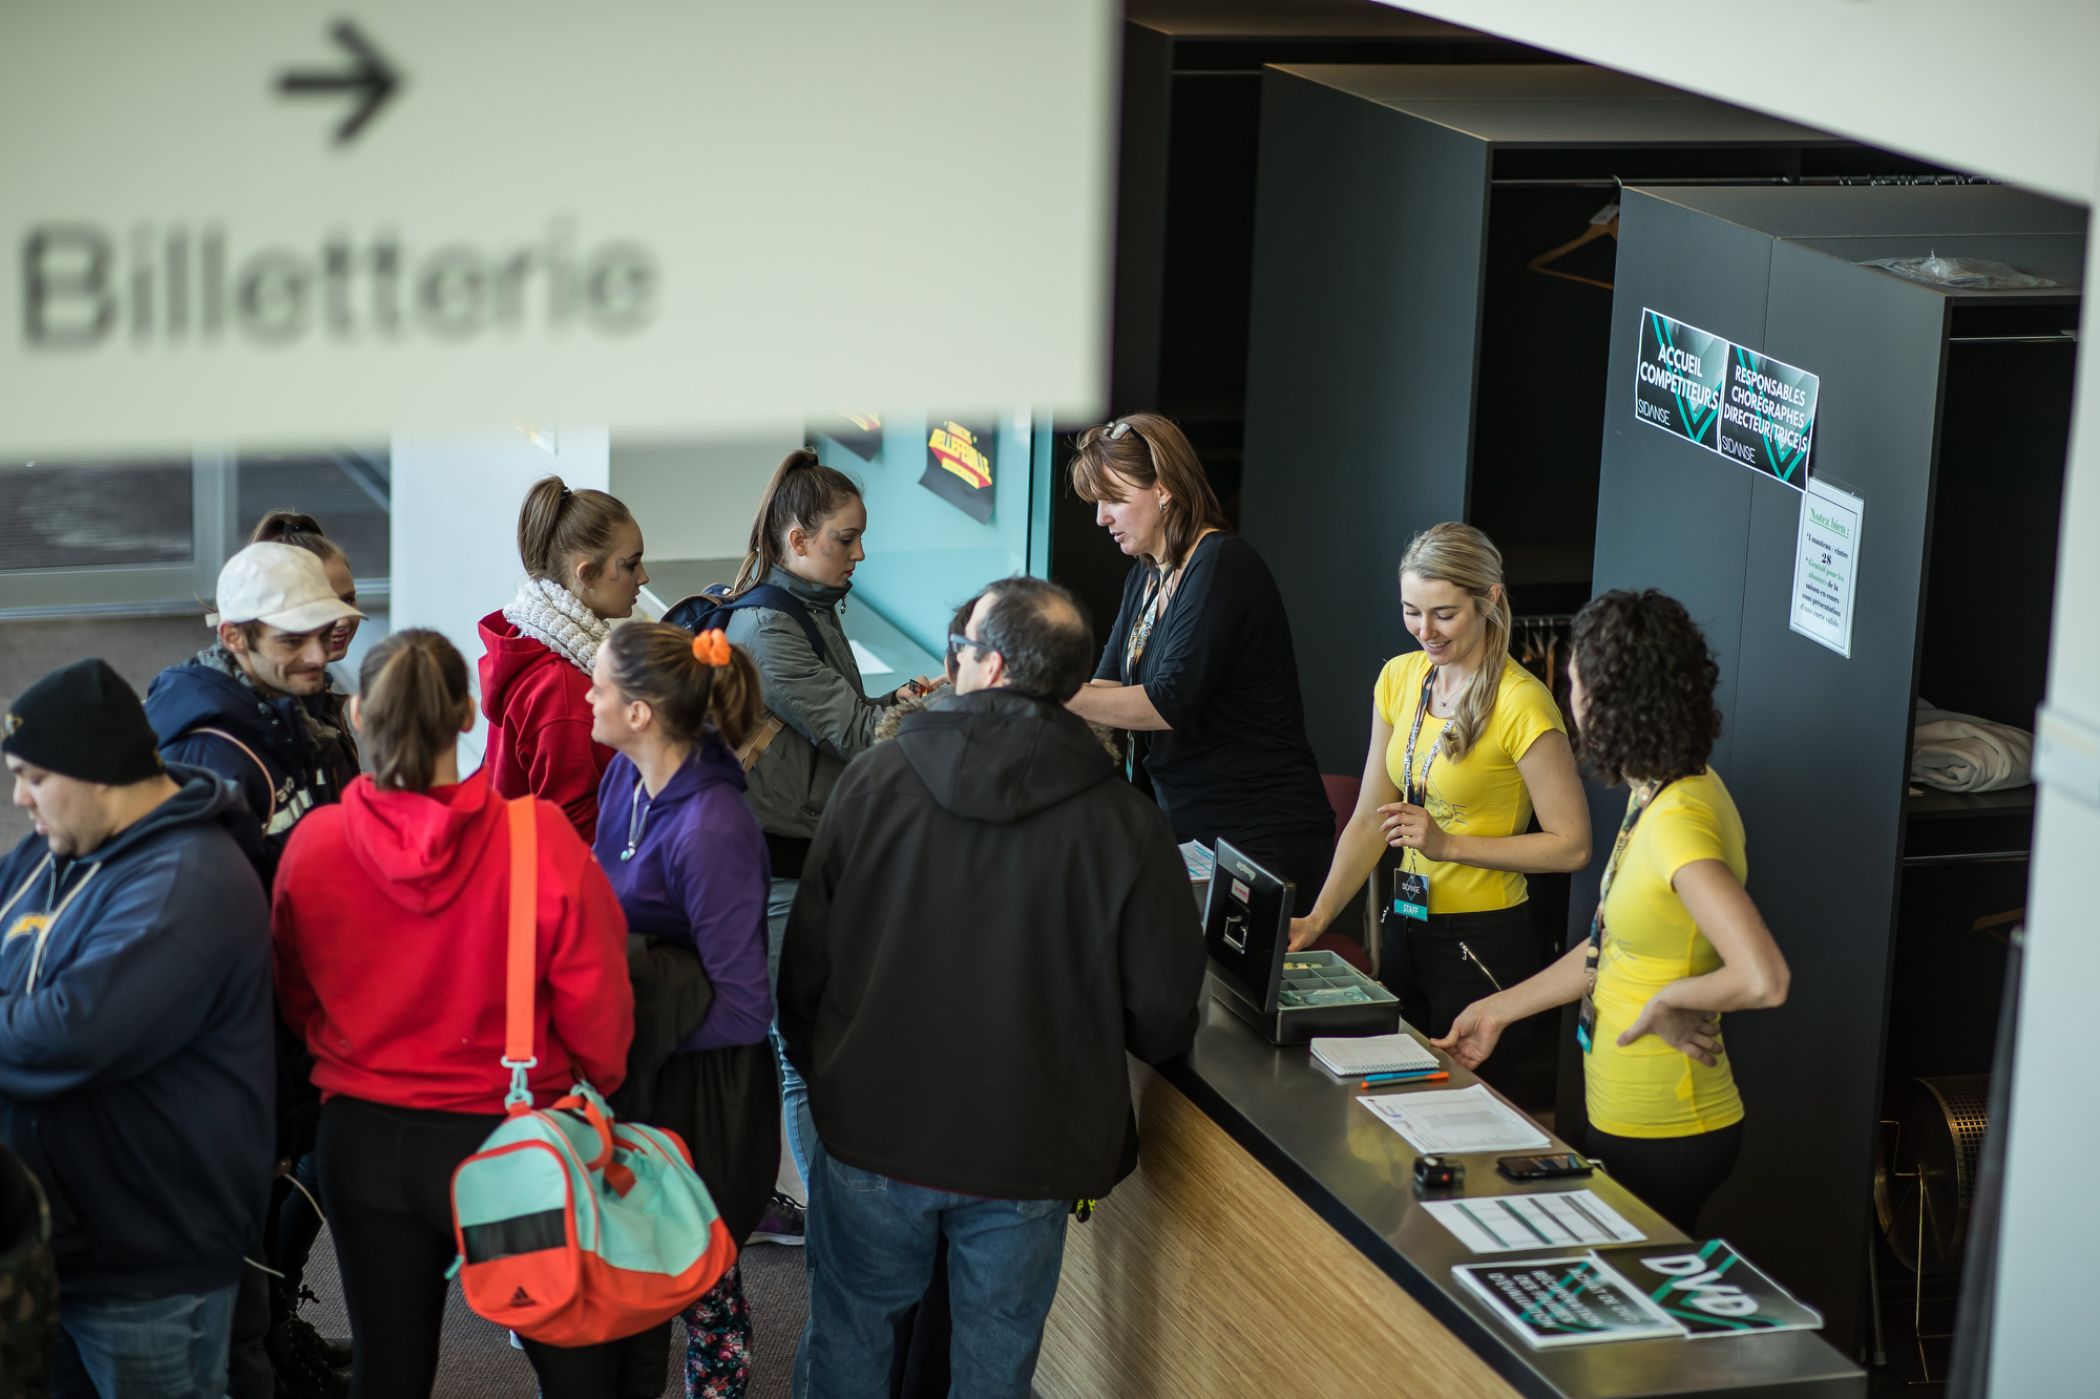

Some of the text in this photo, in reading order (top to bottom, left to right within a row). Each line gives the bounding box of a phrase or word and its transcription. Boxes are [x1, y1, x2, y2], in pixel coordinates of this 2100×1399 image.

[20, 212, 660, 351] Billetterie
[1657, 343, 1703, 378] ACCUEIL
[1735, 364, 1806, 407] RESPONSABLES
[1640, 361, 1720, 411] COMPÉTITEURS
[1731, 385, 1805, 428] CHORÉGRAPHES
[1724, 402, 1808, 454] DIRECTEUR(TRICE)S
[1640, 1253, 1759, 1317] DVD
